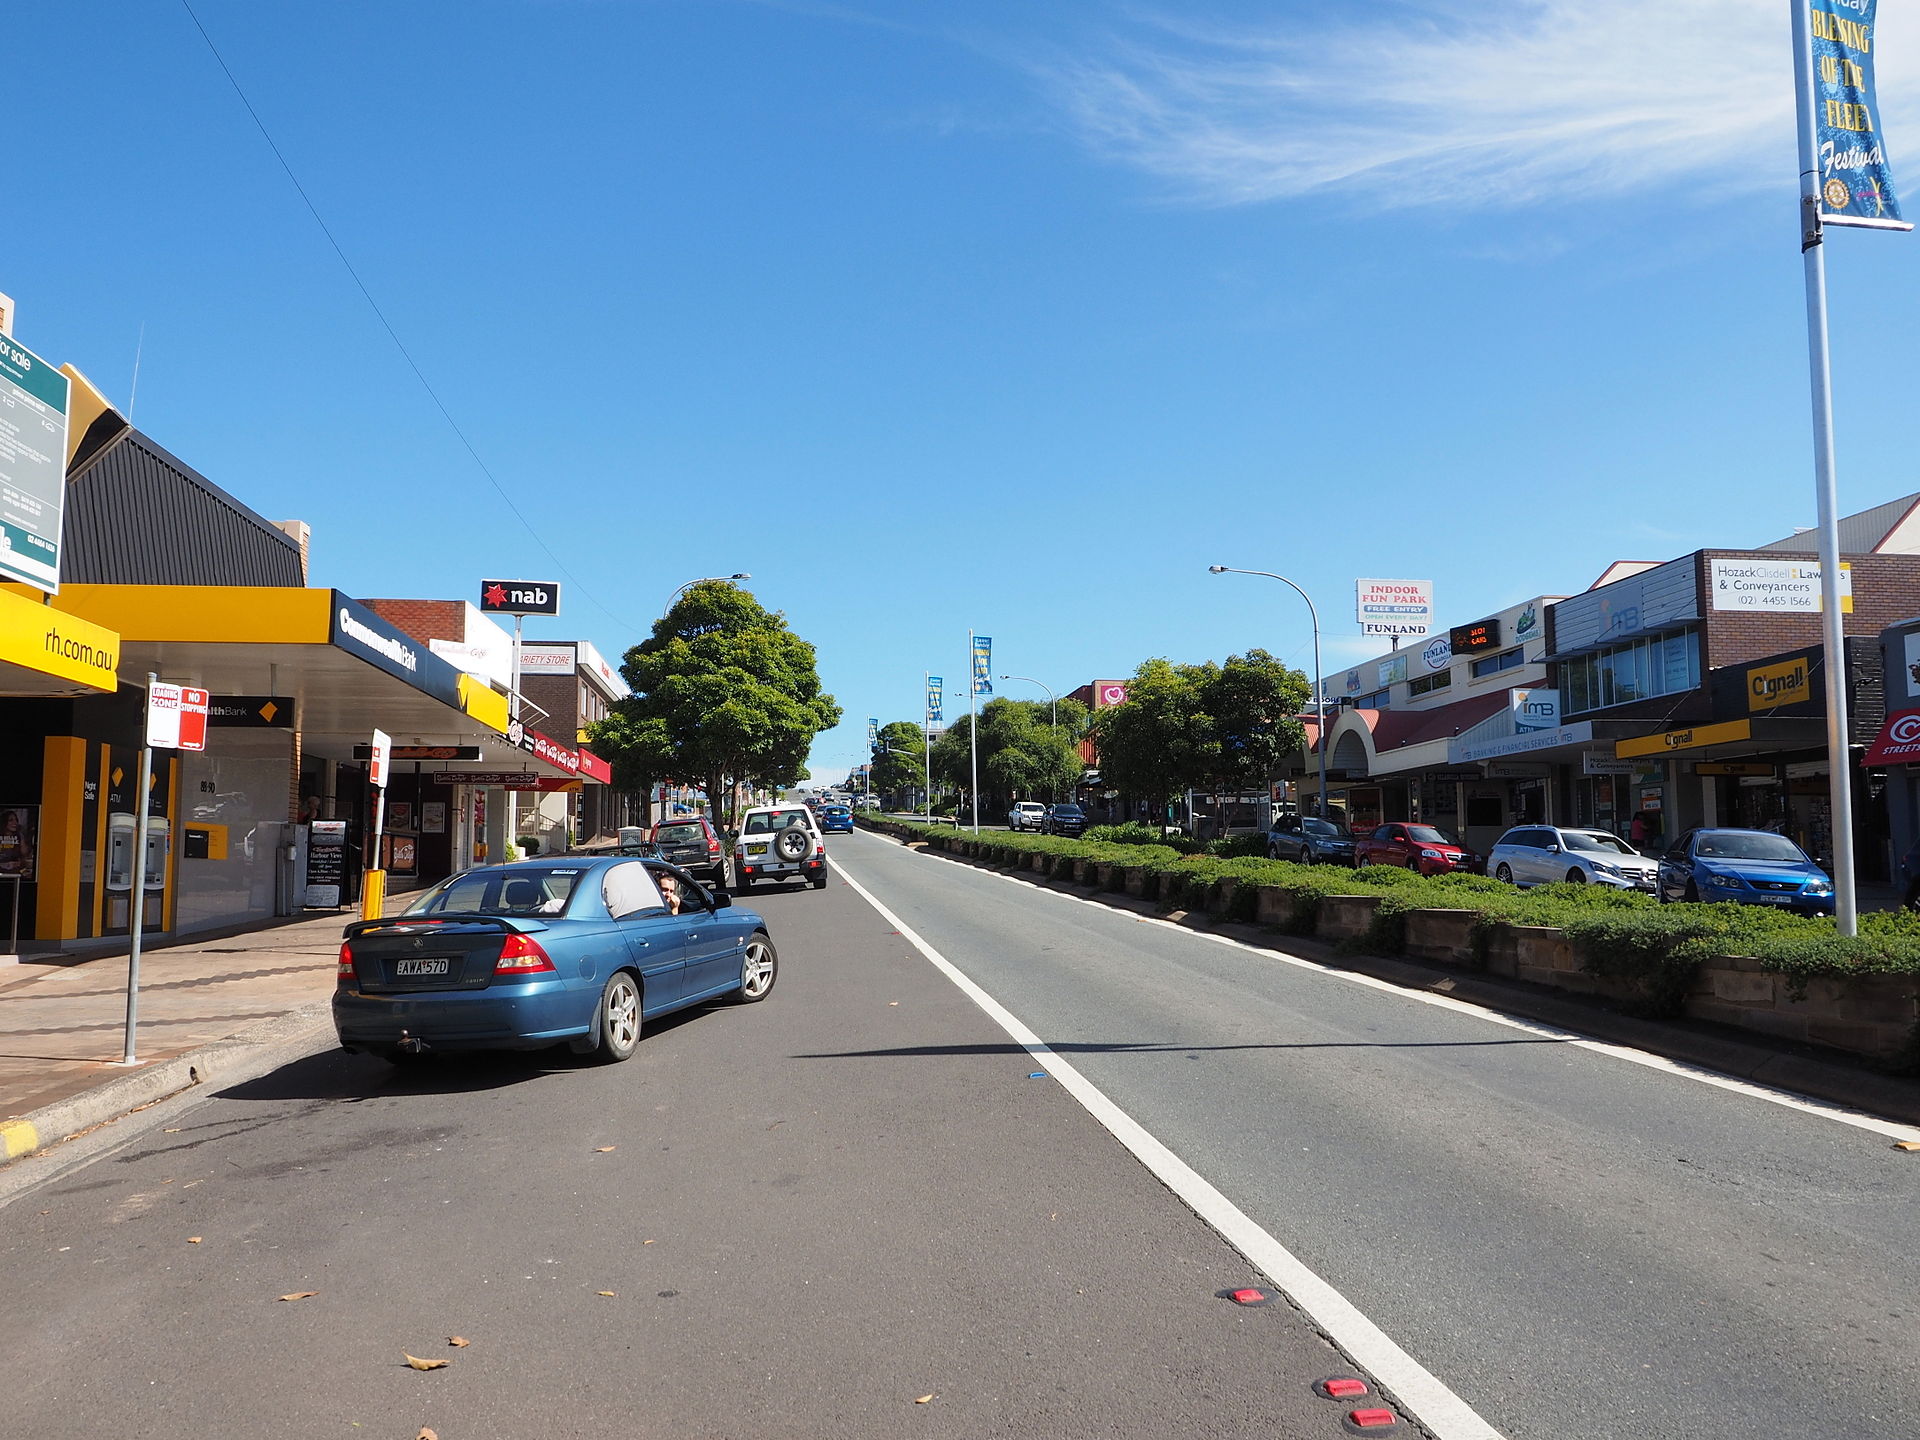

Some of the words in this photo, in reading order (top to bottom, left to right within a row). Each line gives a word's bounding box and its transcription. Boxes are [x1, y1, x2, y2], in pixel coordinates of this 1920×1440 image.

[1821, 55, 1837, 84] OF
[1820, 139, 1884, 178] Festival
[11, 349, 31, 372] sale
[1799, 568, 1845, 580] Laws
[1370, 585, 1419, 594] INDOOR
[1720, 580, 1728, 590] &
[1733, 580, 1810, 593] Conveyancers
[510, 587, 548, 605] nab
[1362, 594, 1388, 603] FUN
[1393, 595, 1427, 604] PARK
[1738, 595, 1757, 605] (02)
[1762, 595, 1786, 605] 4455
[1790, 596, 1811, 606] 1566
[1367, 624, 1427, 634] FUNLAND
[45, 627, 112, 671] rh.com.au
[1423, 643, 1451, 660] FUNLAN
[546, 655, 571, 665] STORE
[1752, 666, 1804, 701] Cignall
[152, 688, 178, 699] LOADING
[188, 692, 200, 703] NO
[152, 697, 178, 709] ZONE
[180, 703, 206, 714] STOPPING
[1531, 736, 1558, 748] SERVICES
[1665, 730, 1693, 750] Cignall
[85, 780, 96, 791] Night
[84, 791, 95, 800] Safe
[110, 793, 121, 803] ATM
